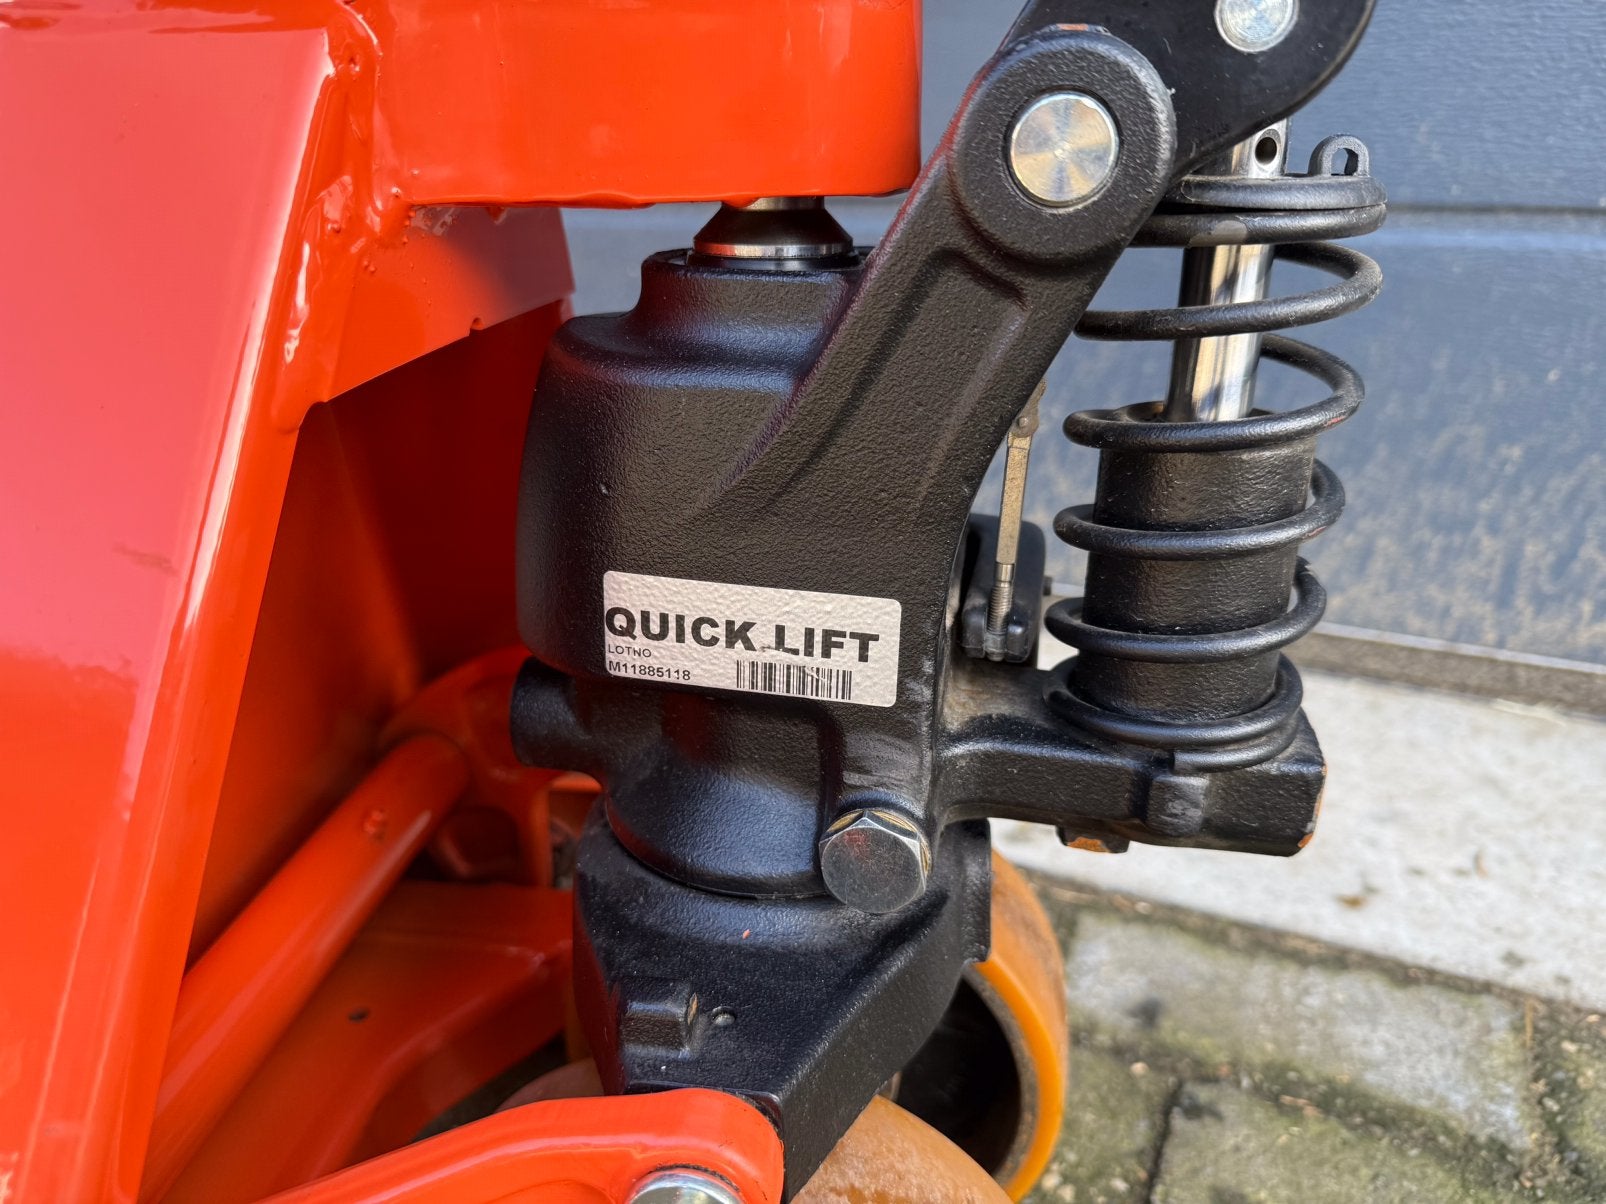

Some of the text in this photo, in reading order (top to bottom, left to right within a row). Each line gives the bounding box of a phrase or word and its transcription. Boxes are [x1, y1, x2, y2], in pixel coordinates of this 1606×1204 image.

[605, 606, 880, 662] QUICK LIFT
[608, 644, 652, 658] LOTNO
[608, 660, 691, 681] M11885118
